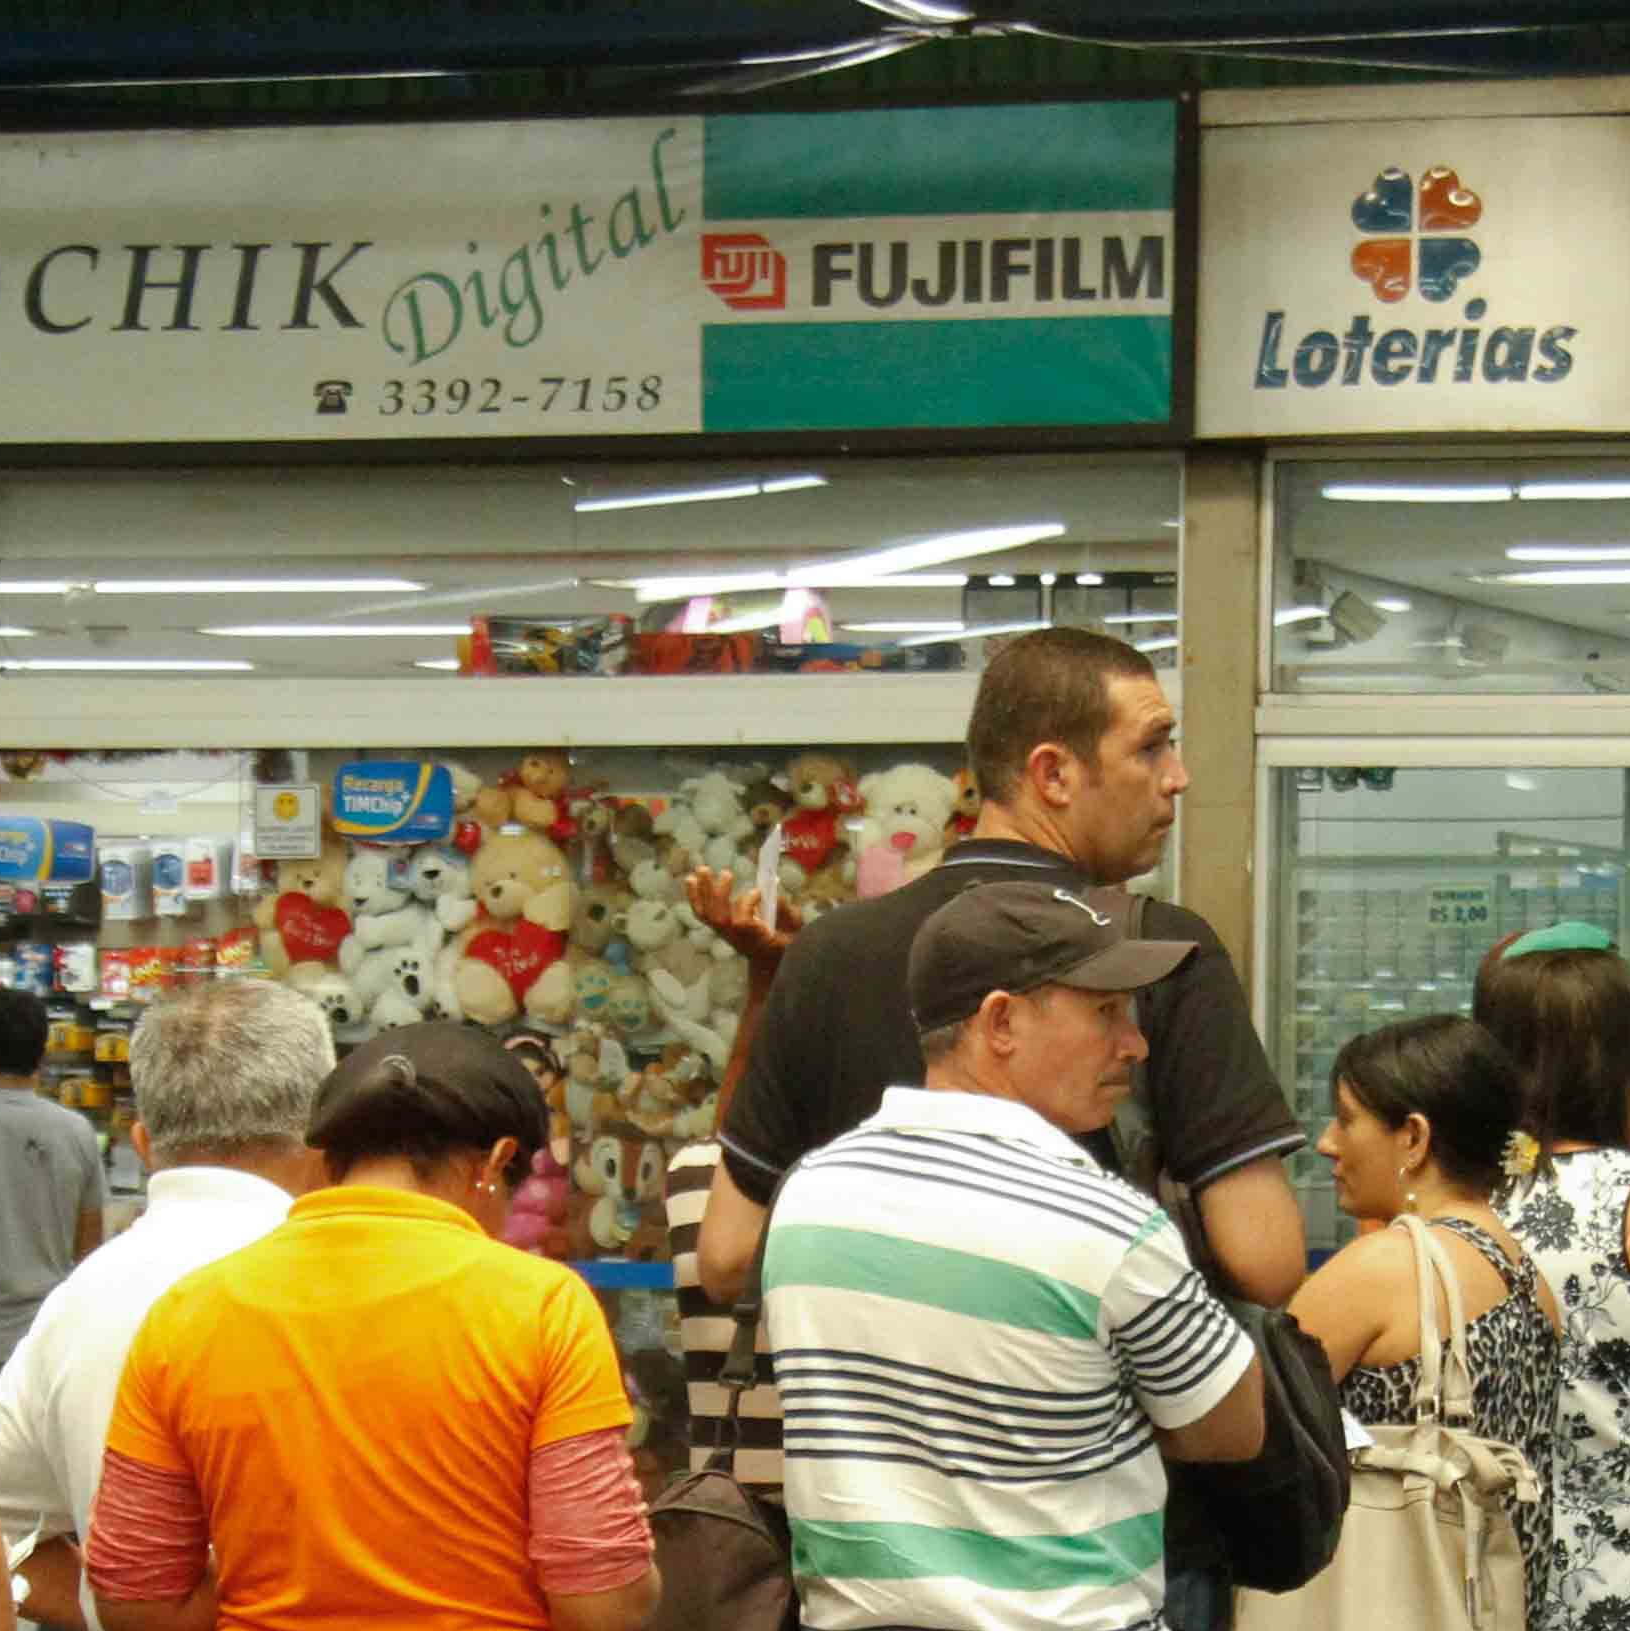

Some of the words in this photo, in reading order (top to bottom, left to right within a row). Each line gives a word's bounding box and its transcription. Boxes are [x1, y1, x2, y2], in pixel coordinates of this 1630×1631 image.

[381, 128, 687, 366] Digital
[810, 235, 1165, 308] FUJIFILM
[1253, 297, 1579, 390] Loterias
[378, 374, 665, 416] 3392-7158
